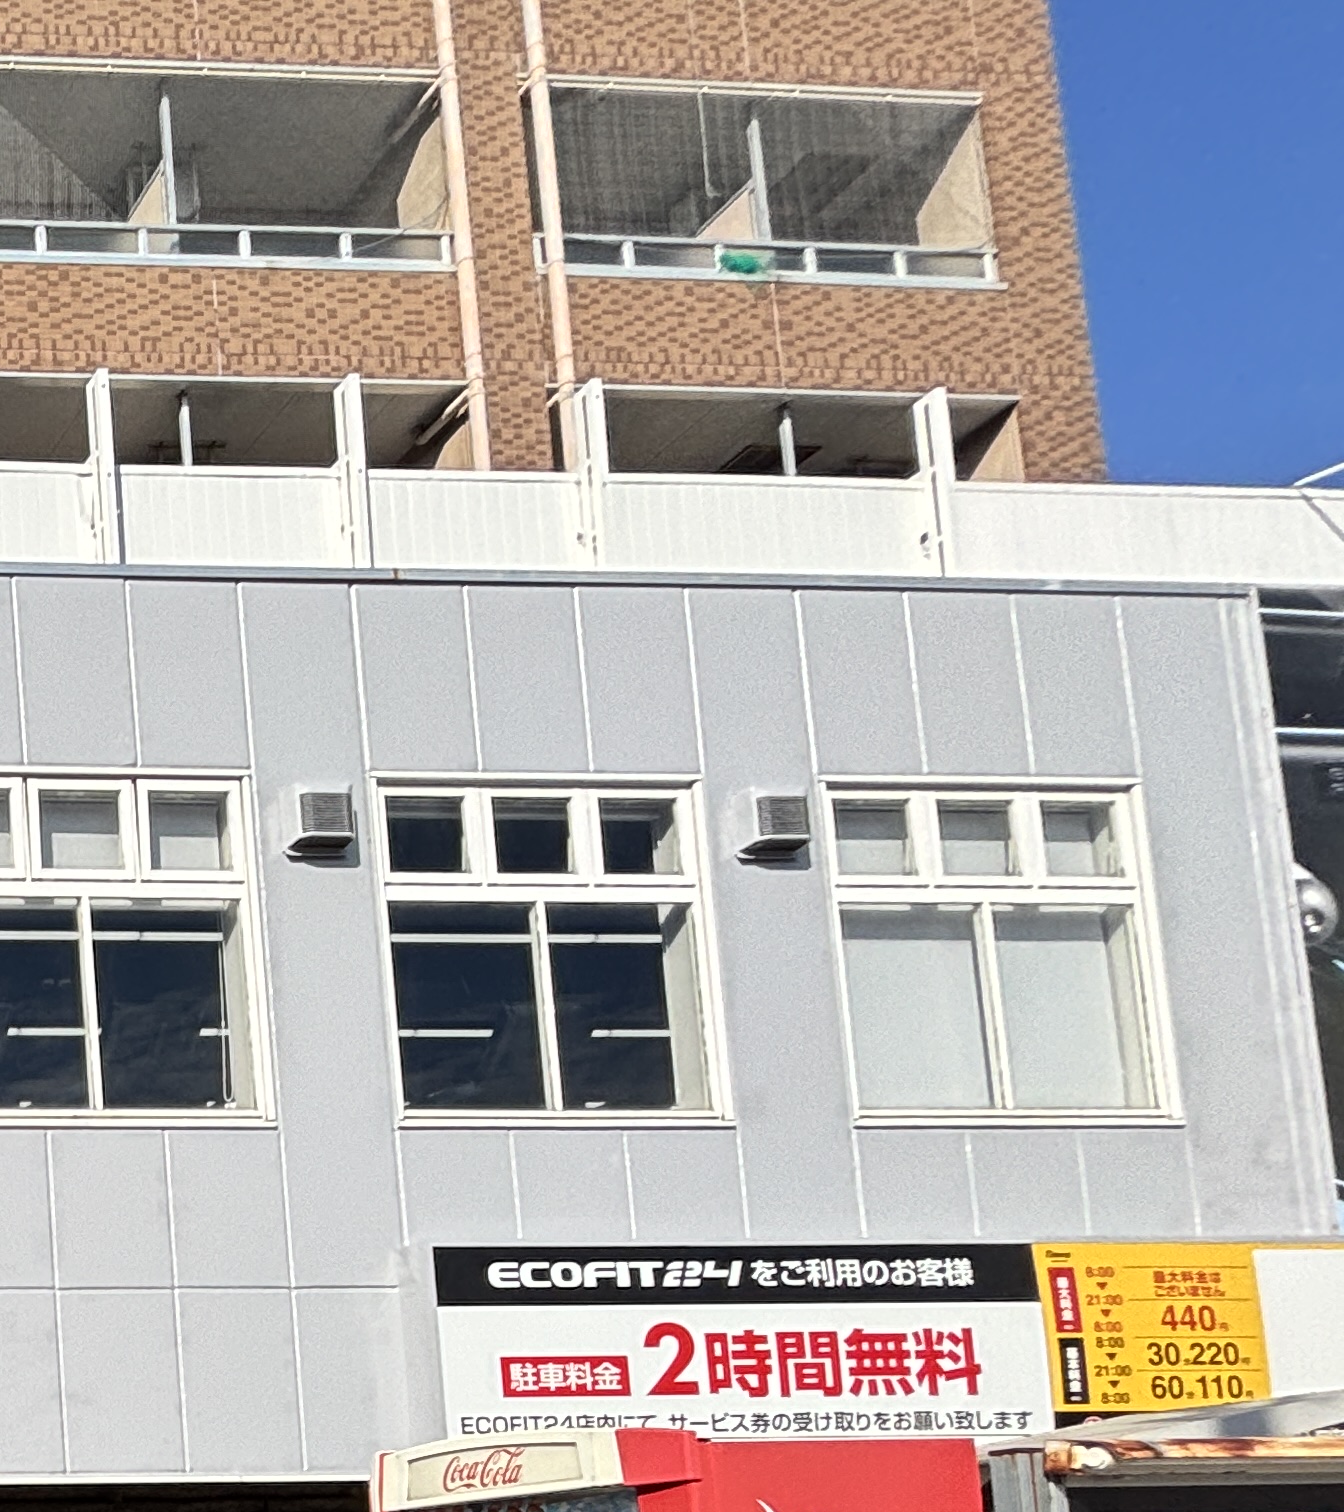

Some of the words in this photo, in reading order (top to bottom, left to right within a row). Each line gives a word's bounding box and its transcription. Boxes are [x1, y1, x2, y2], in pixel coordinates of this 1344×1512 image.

[487, 1257, 975, 1289] ECOFIT24をご利用のお客様
[511, 1361, 623, 1393] 駐車料金
[643, 1321, 982, 1398] 2時間無料
